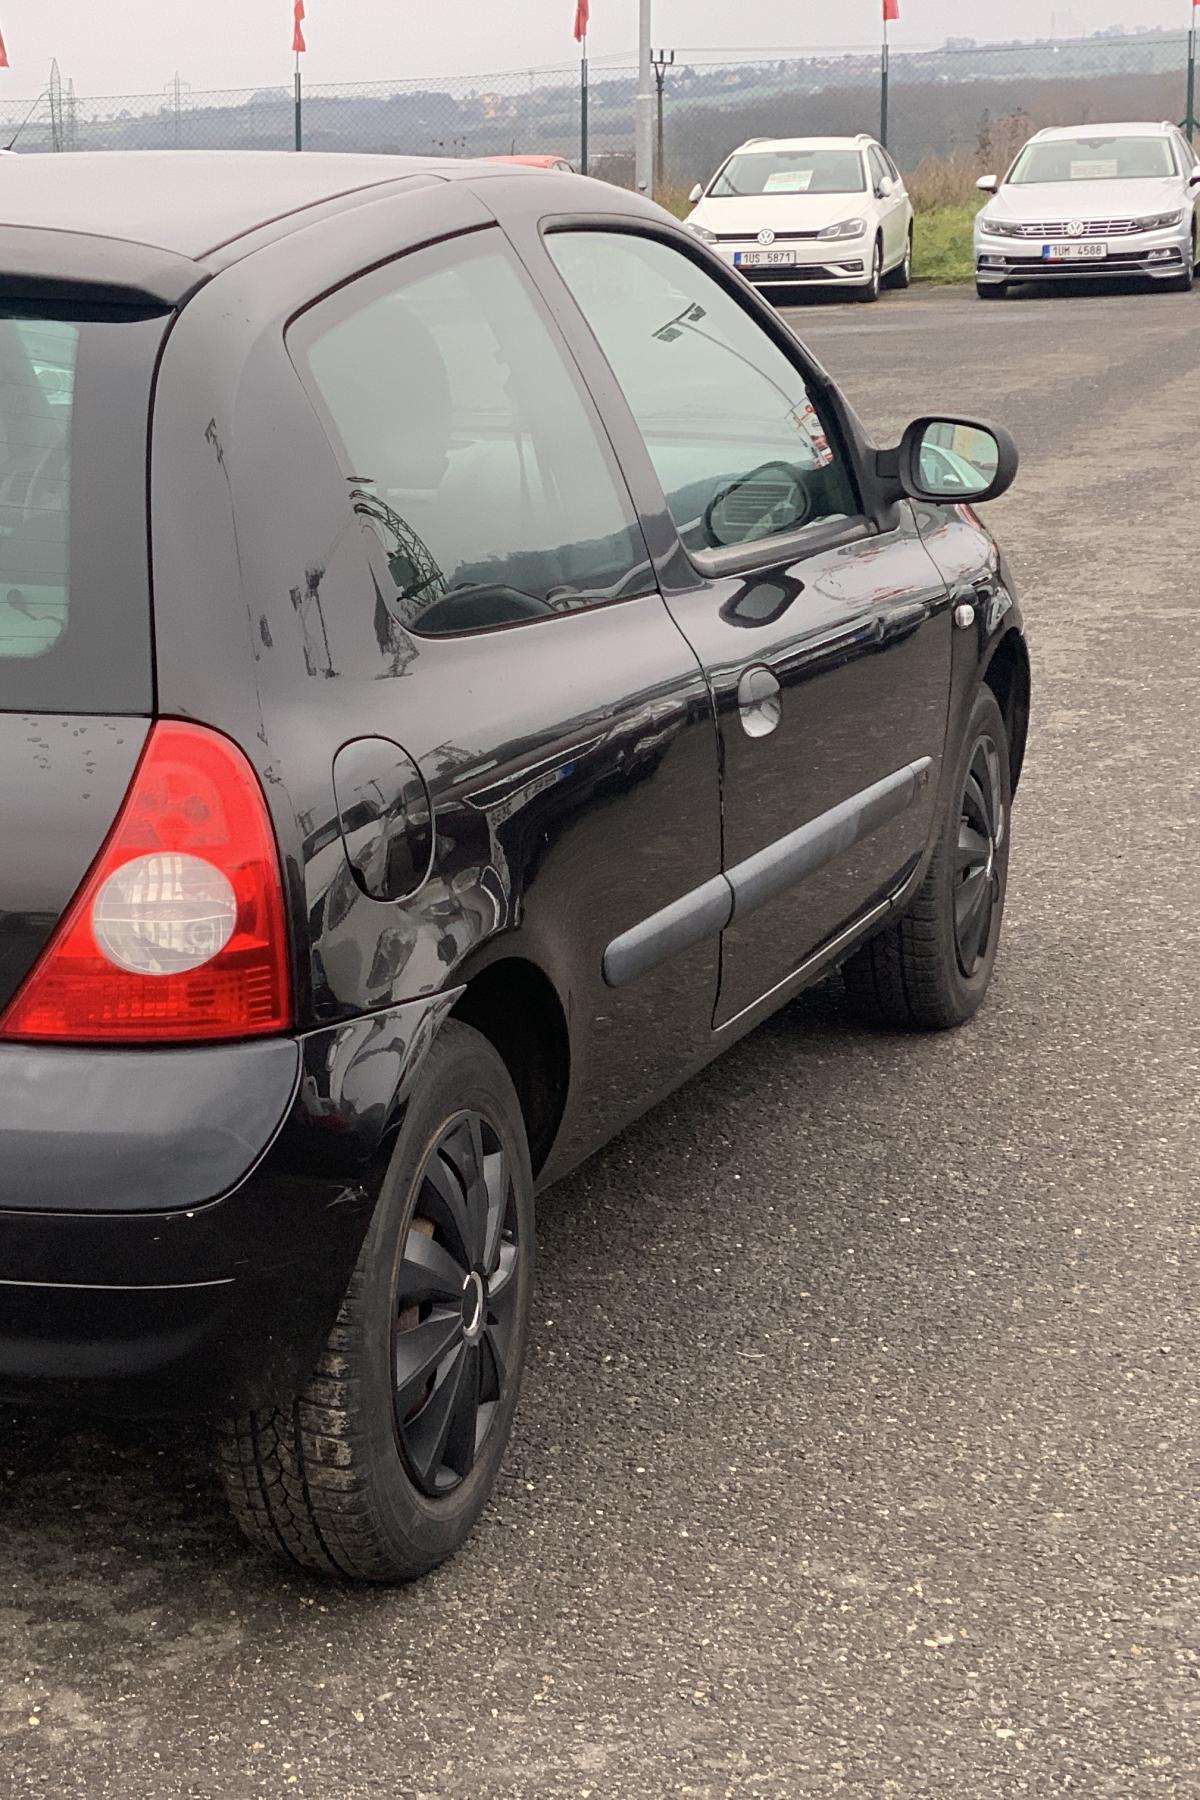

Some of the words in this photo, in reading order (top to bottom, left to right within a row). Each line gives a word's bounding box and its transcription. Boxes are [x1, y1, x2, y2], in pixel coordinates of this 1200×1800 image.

[1077, 244, 1102, 256] 4588
[744, 254, 760, 263] 1US
[767, 253, 790, 262] 5871
